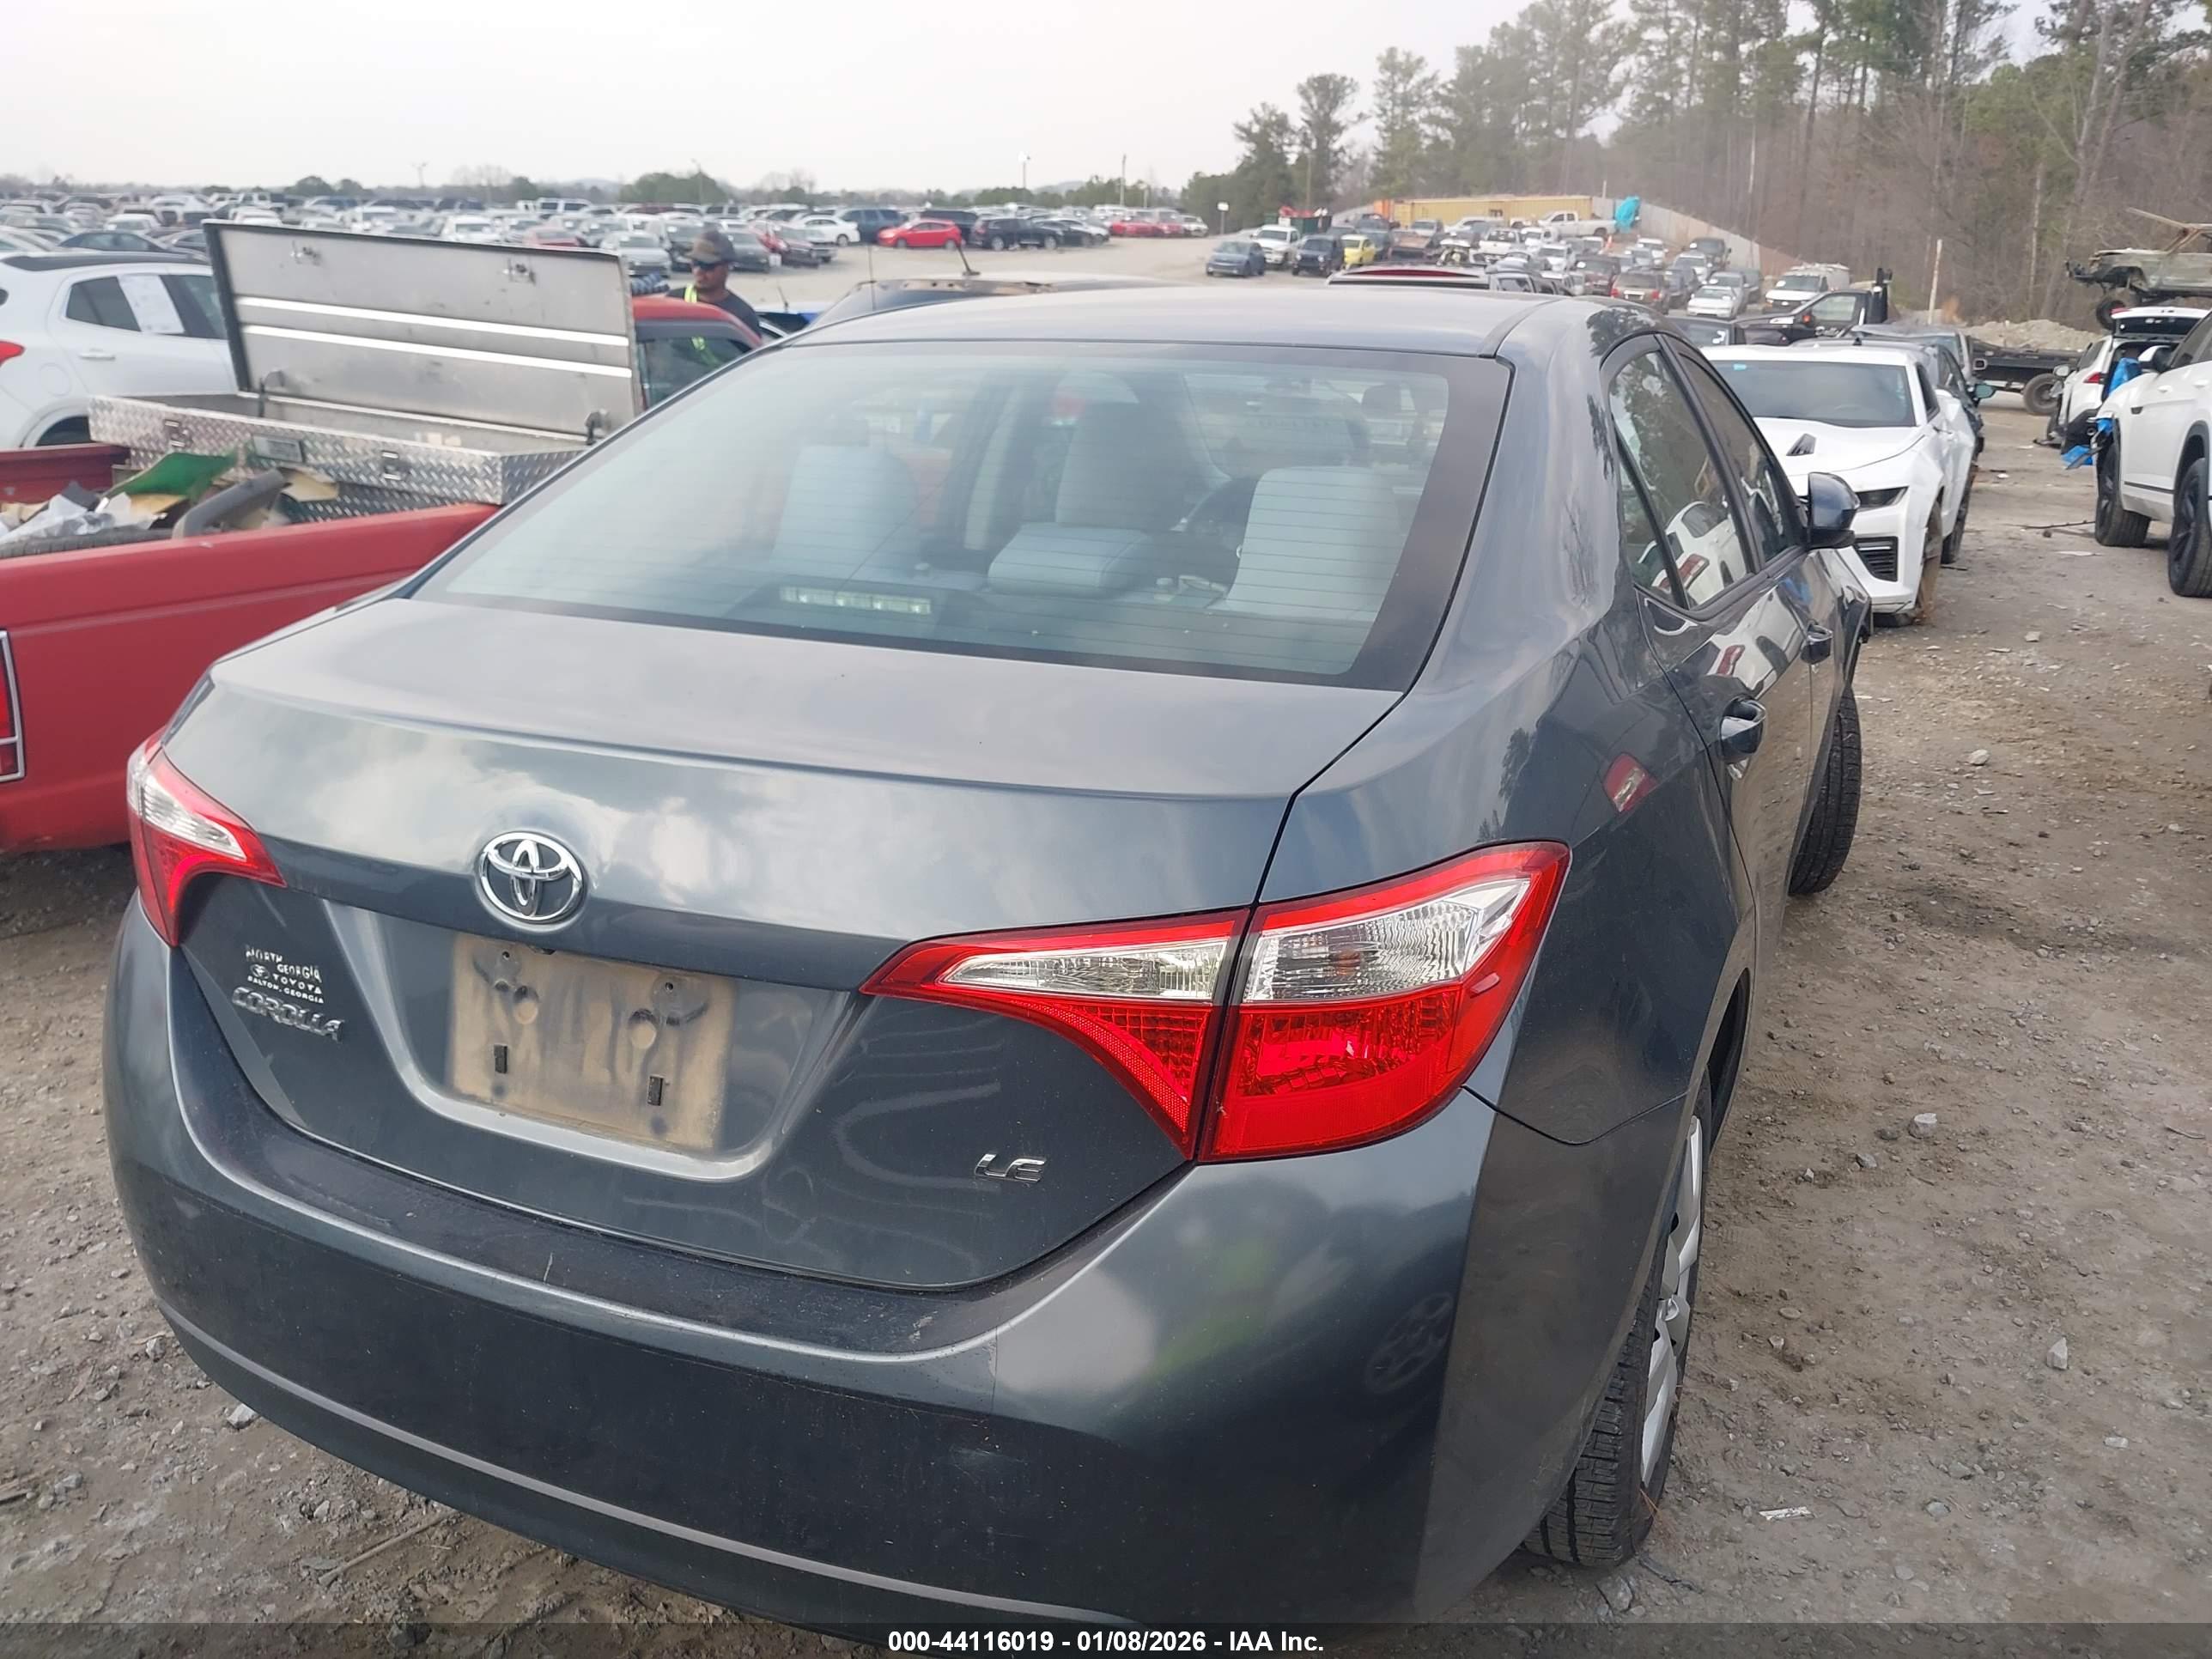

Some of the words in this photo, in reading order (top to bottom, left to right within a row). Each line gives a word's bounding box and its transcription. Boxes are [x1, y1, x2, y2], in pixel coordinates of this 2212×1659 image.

[245, 947, 283, 963] NORTH
[276, 963, 323, 983] GEORGIA
[272, 973, 323, 994] TOYOTA
[283, 987, 324, 1004] GEORGIA
[232, 987, 344, 1042] COROLLA
[974, 1153, 1046, 1182] LE
